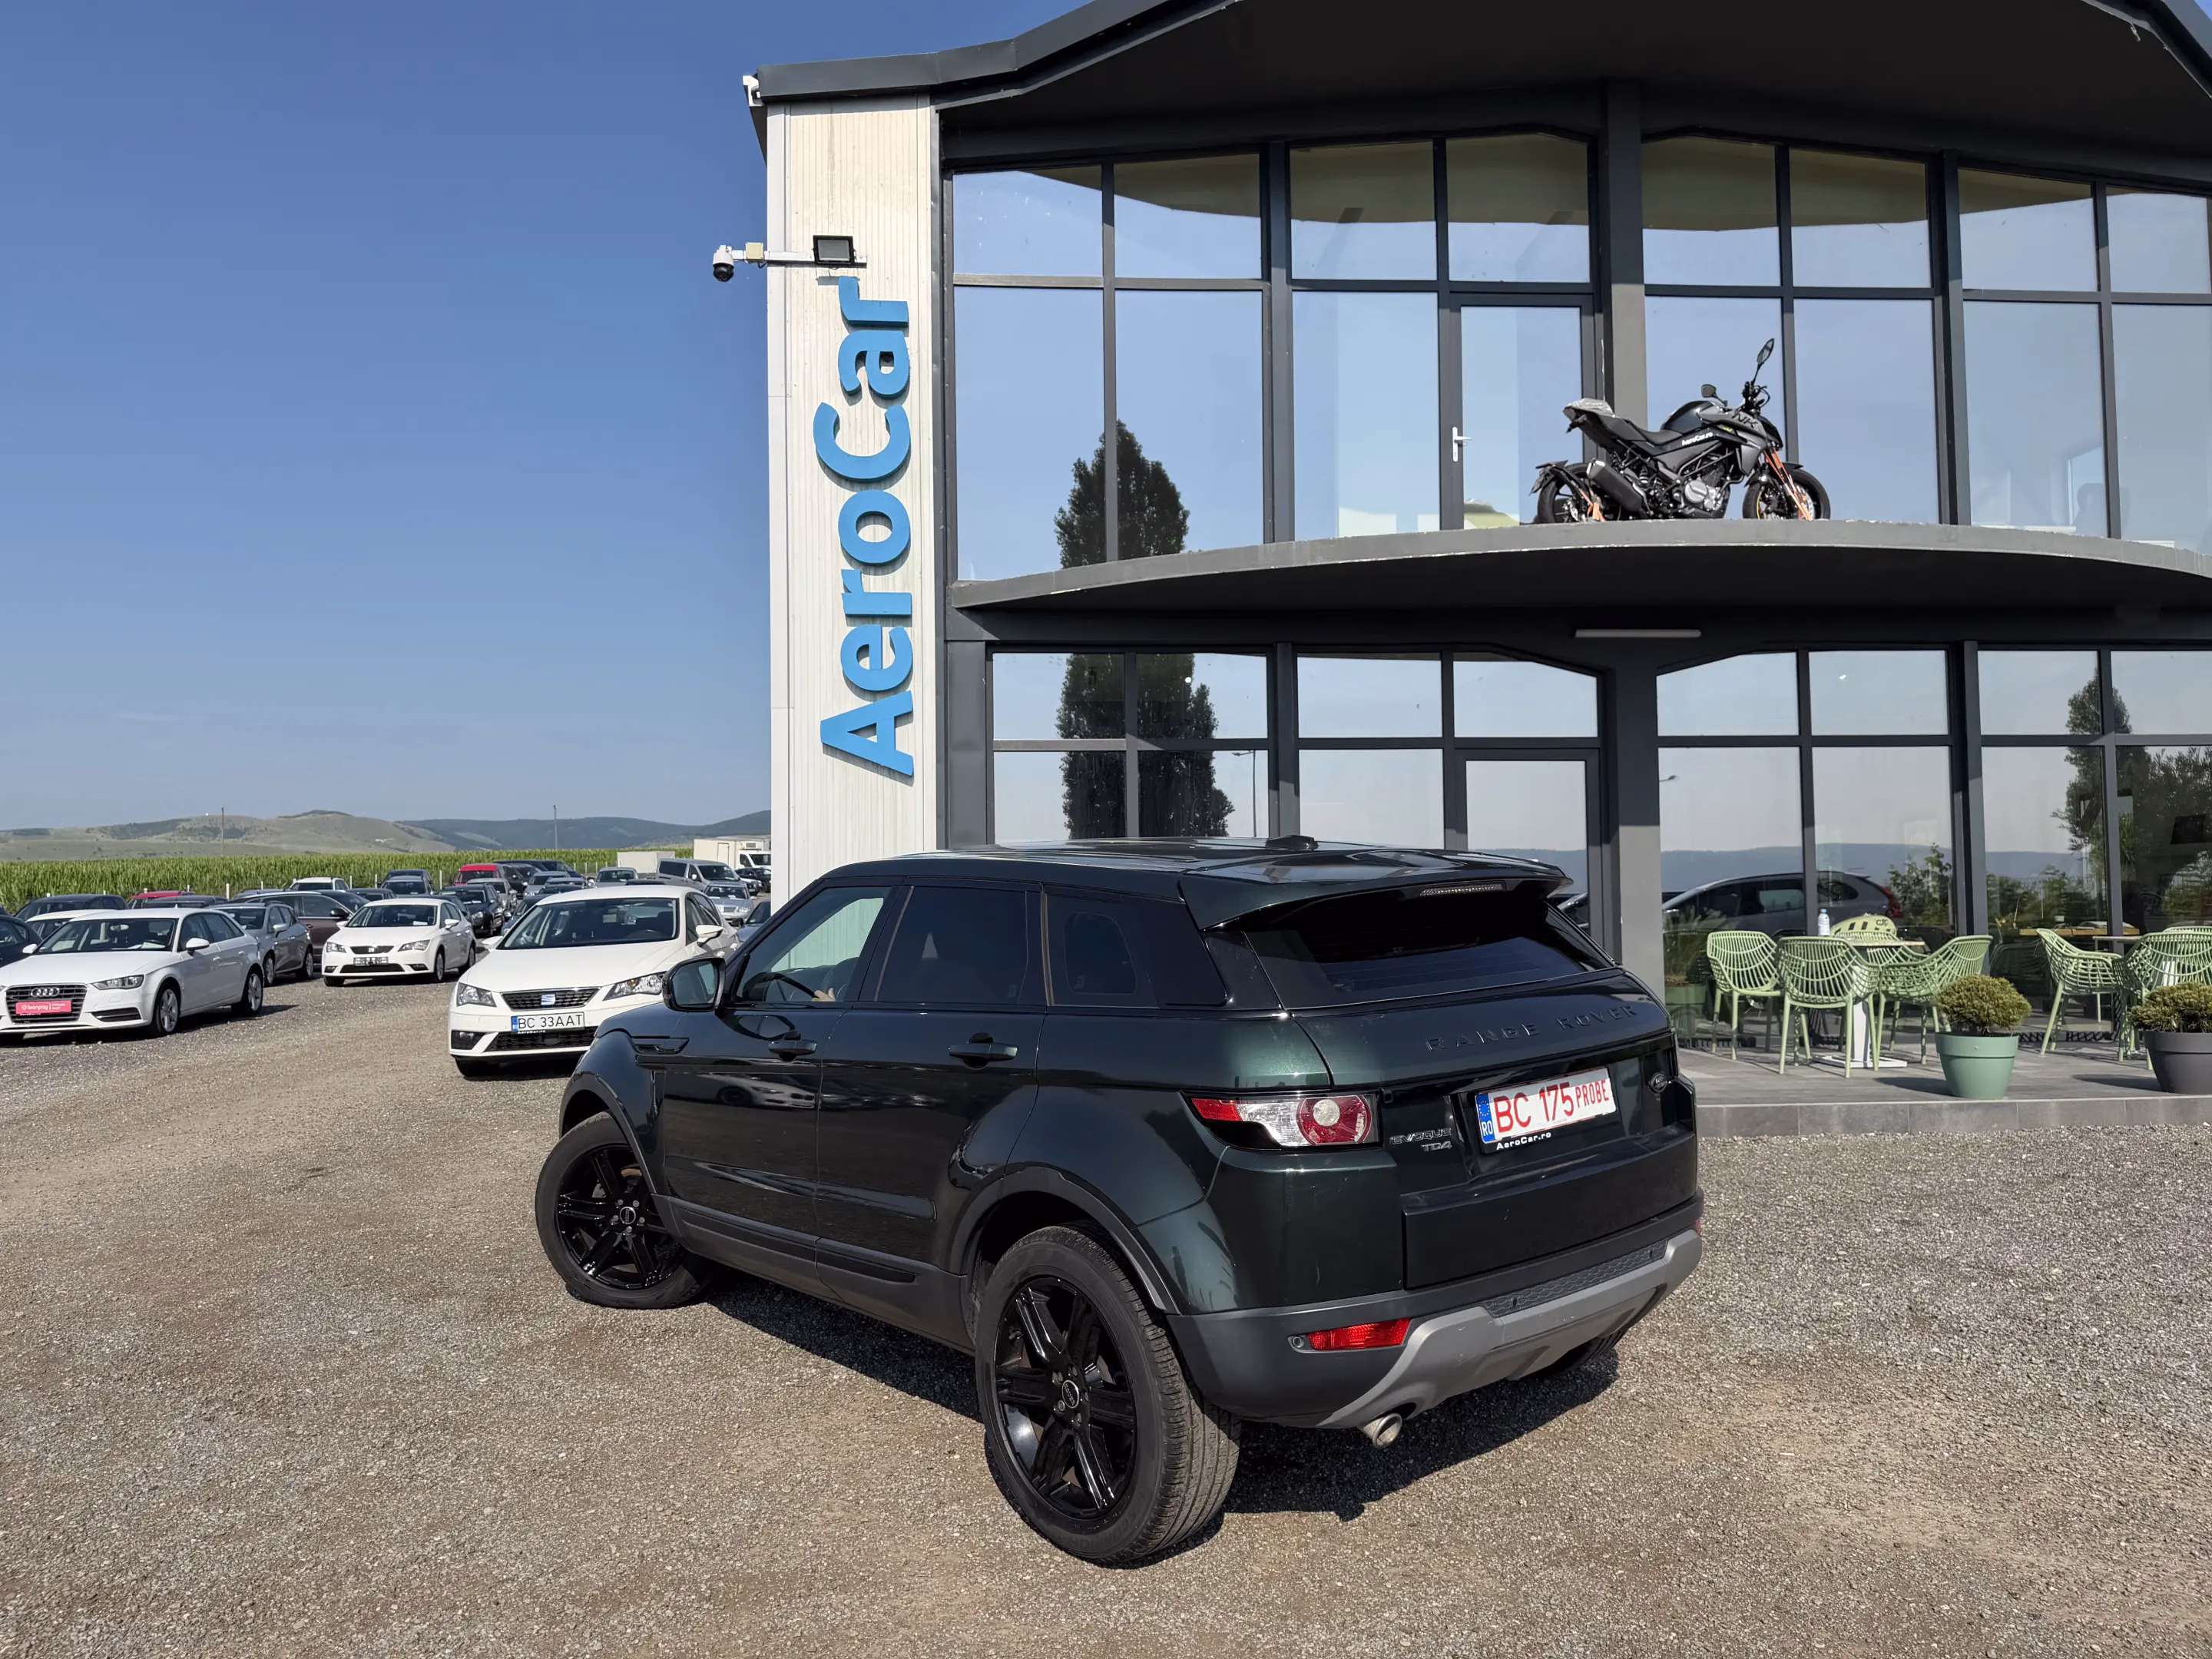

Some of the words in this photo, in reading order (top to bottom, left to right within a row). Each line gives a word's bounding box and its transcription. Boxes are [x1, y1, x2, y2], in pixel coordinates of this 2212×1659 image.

[813, 275, 914, 777] AeroCar
[518, 1017, 535, 1029] BC
[540, 1015, 582, 1028] 33AAT
[1426, 1023, 1539, 1051] RANGE
[1555, 1005, 1638, 1030] ROVER
[1493, 1092, 1532, 1133] BC
[1538, 1081, 1575, 1123] 175
[1575, 1080, 1610, 1109] PROBE
[1389, 1128, 1452, 1145] EVOQUE
[1482, 1121, 1494, 1137] RO
[1421, 1141, 1452, 1152] TD4
[1496, 1132, 1551, 1151] AeroCar.ro
